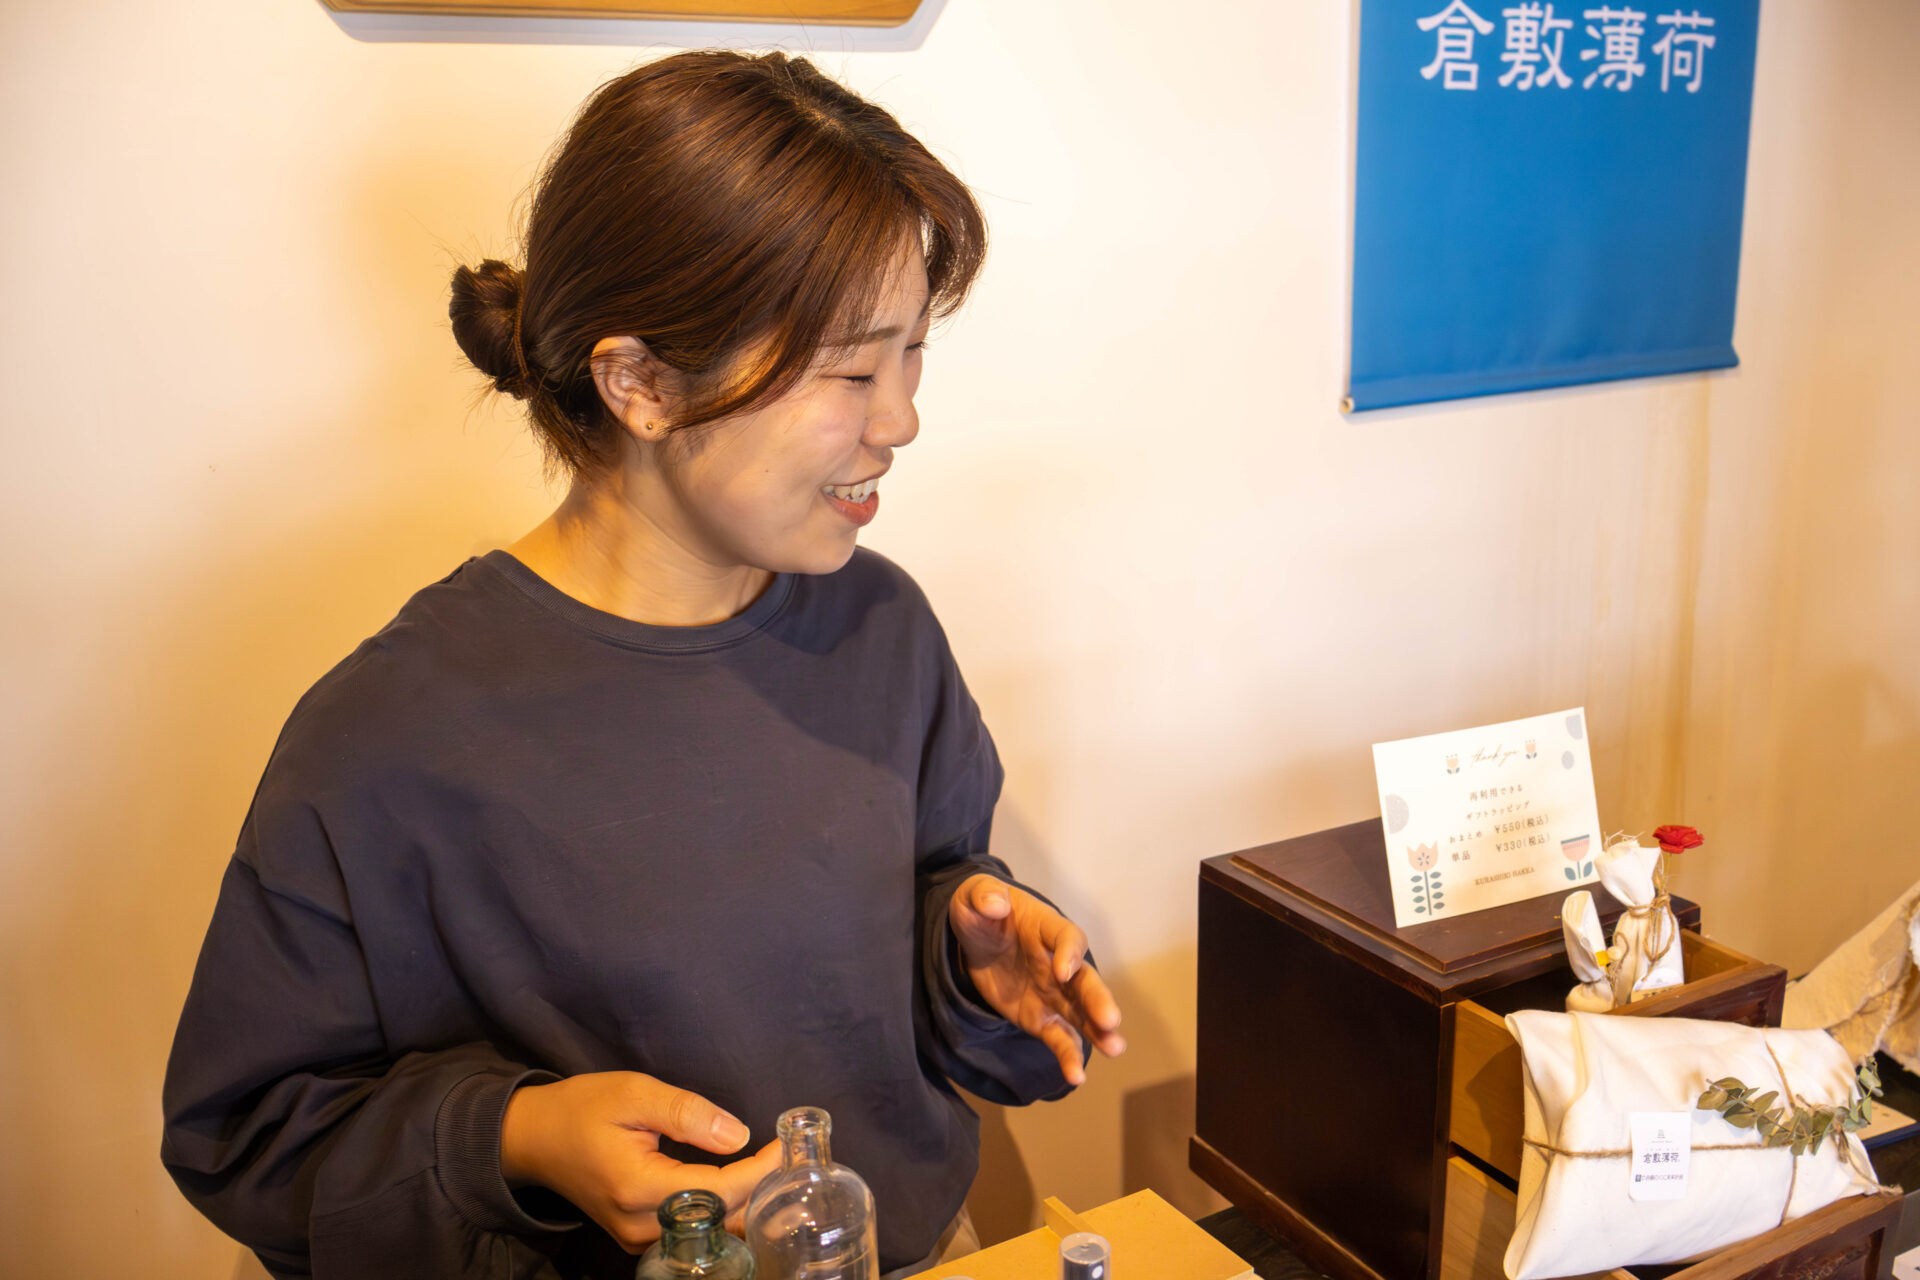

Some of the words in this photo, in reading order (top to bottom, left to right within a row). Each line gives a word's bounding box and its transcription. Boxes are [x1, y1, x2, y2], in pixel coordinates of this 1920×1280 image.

[1416, 0, 1716, 93] 倉敷薄荷
[1469, 784, 1523, 801] 再利用できる
[1466, 800, 1530, 820] ギフトラッピング
[1452, 850, 1471, 862] 単品
[1475, 872, 1511, 886] KURASHIKI
[1512, 867, 1535, 878] HAKKA
